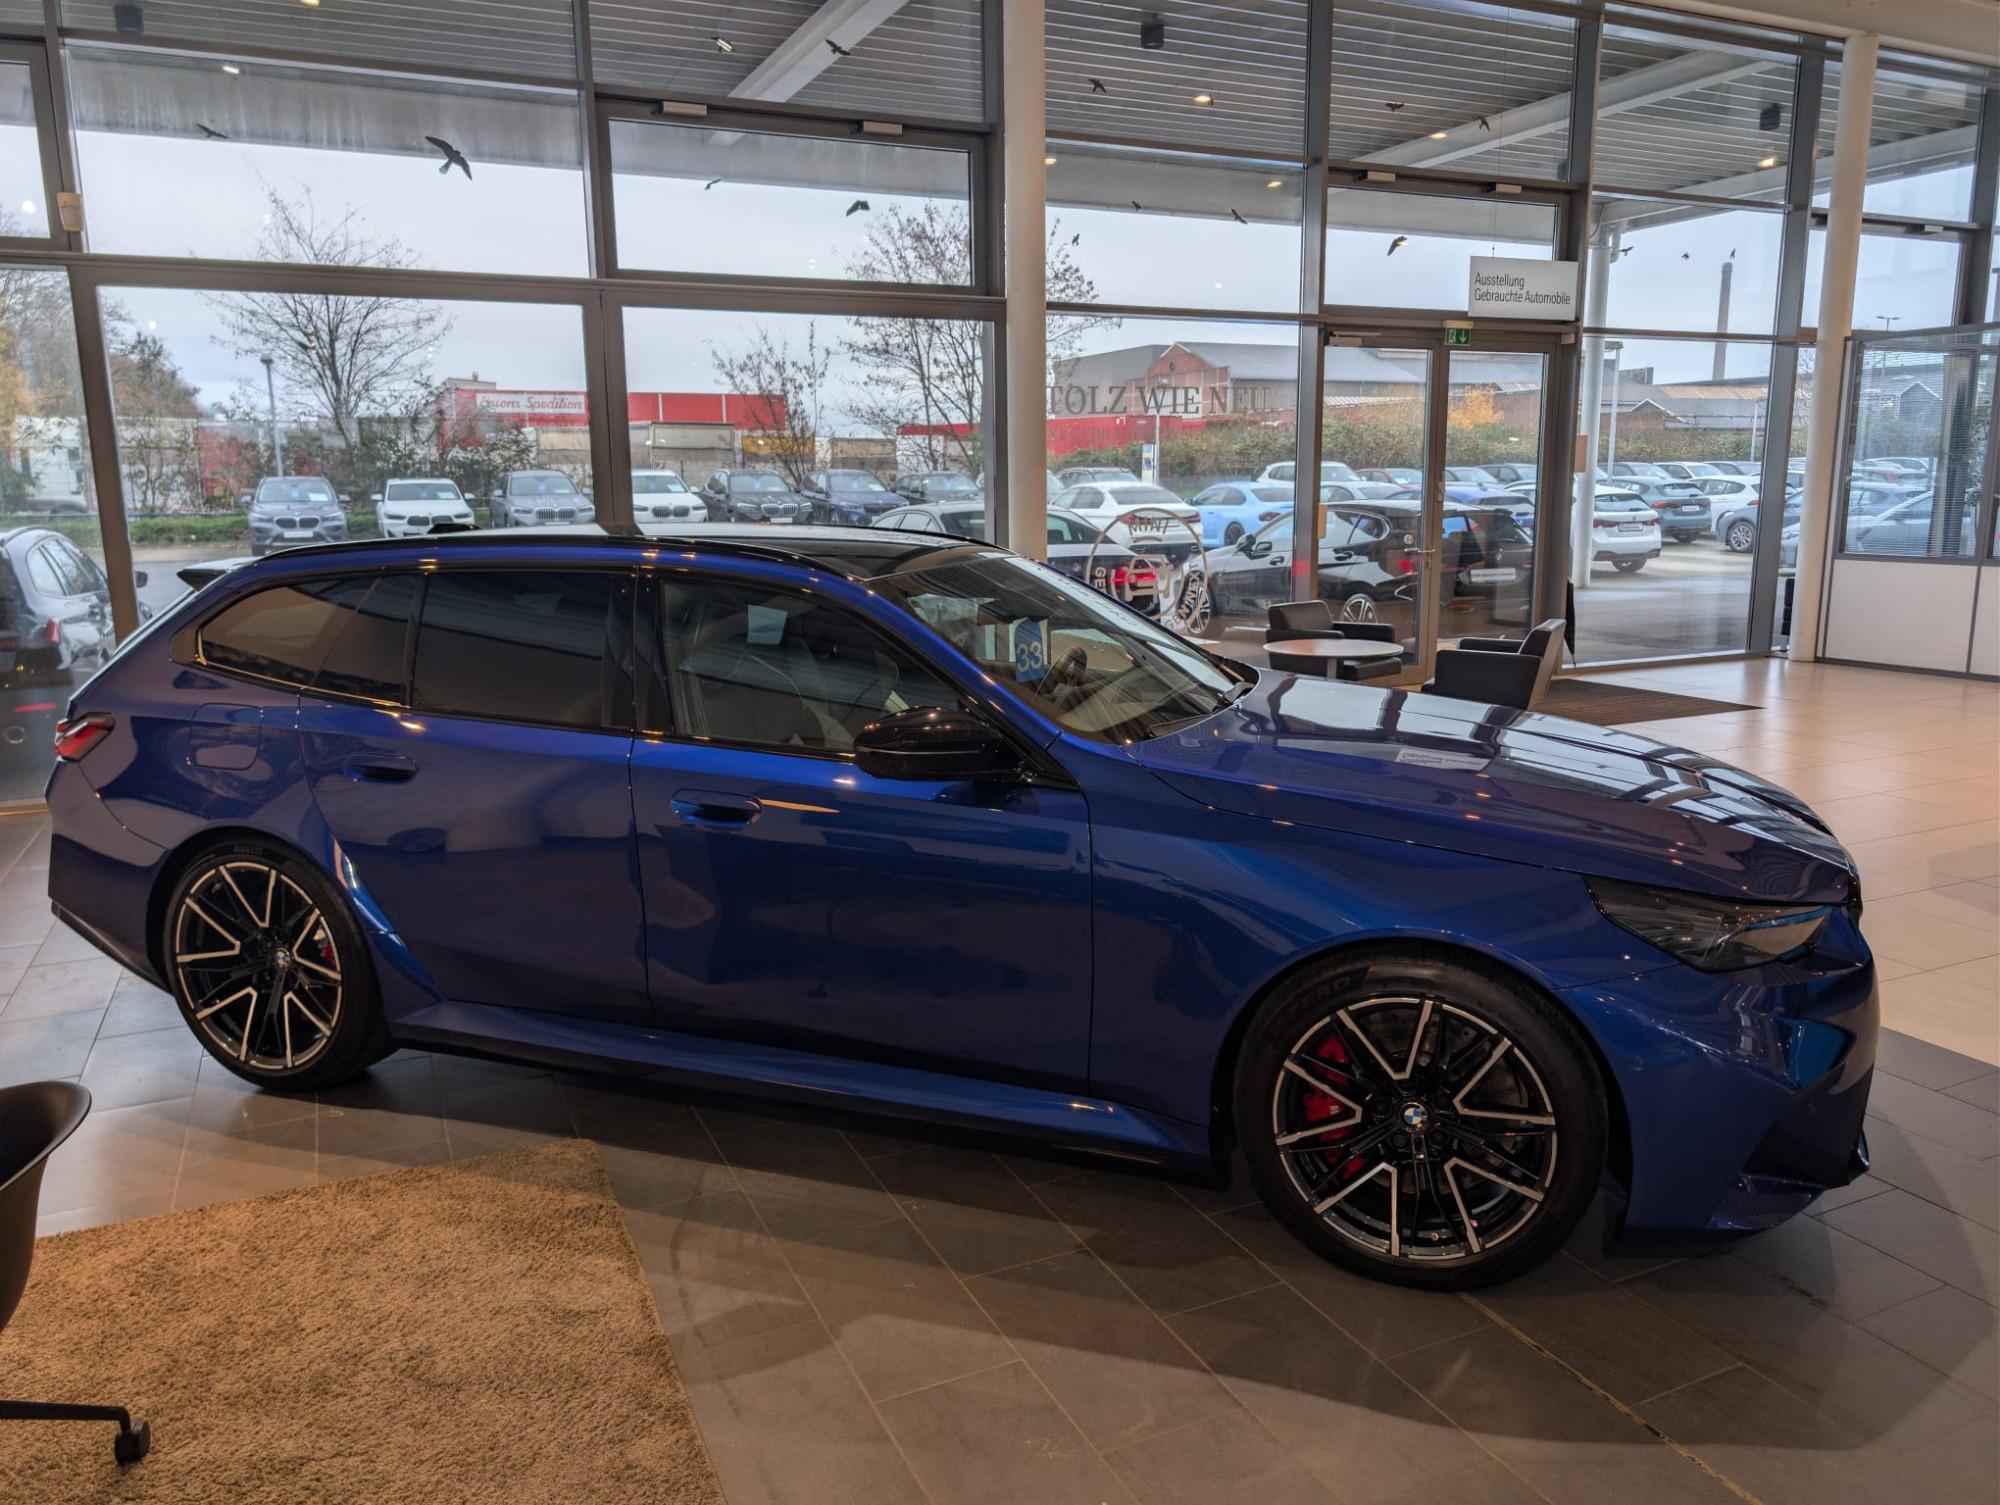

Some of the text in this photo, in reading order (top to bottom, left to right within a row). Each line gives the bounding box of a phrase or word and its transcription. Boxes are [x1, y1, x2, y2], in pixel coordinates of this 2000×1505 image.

[1474, 272, 1525, 290] Ausstellung
[1474, 287, 1571, 305] Gebrauchte Automobile
[526, 396, 582, 411] Spedition
[1045, 385, 1270, 414] TOLZ WIE NEU
[1128, 518, 1168, 535] MINI
[1017, 641, 1042, 672] 33
